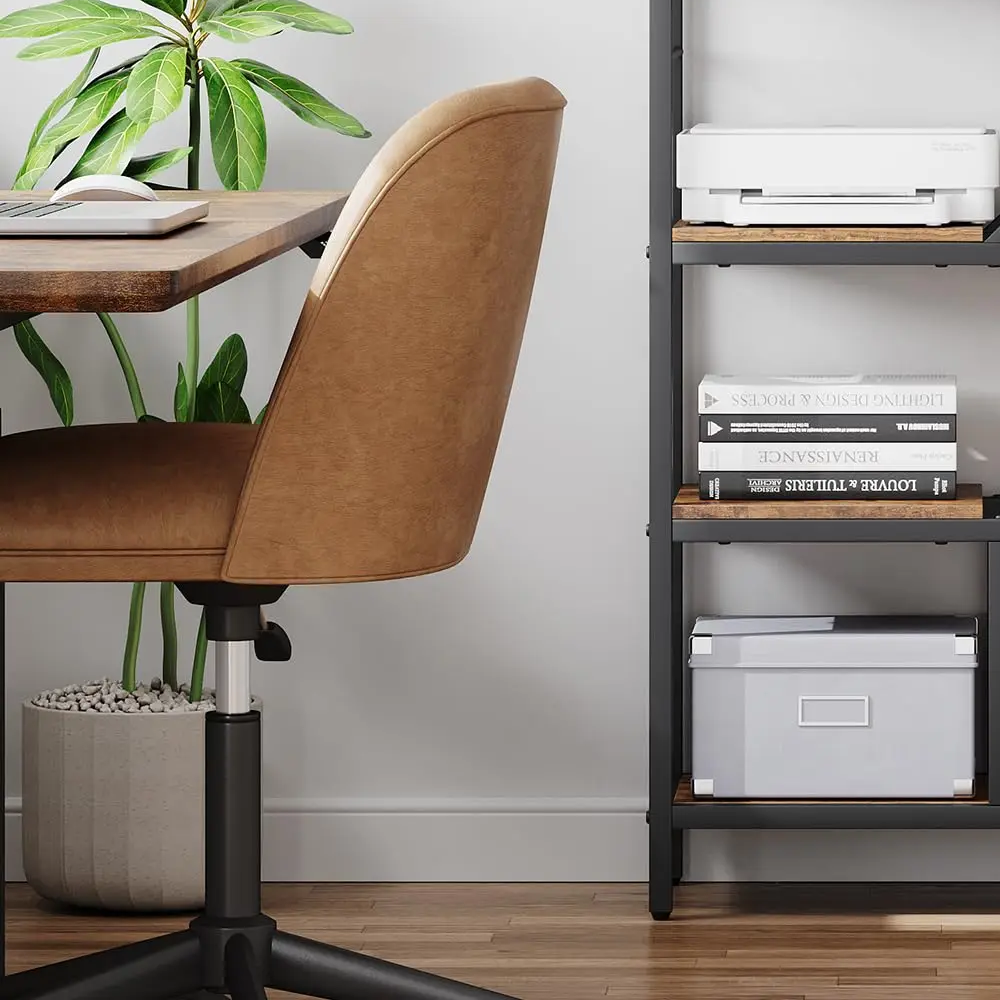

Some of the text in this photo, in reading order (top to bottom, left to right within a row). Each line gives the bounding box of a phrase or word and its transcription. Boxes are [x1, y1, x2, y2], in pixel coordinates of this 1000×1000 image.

[731, 393, 944, 407] LIGHTING DESIGN & PROCESS
[758, 450, 880, 463] RENAISSANCE
[785, 479, 917, 492] LOUVRE & TUILERIS
